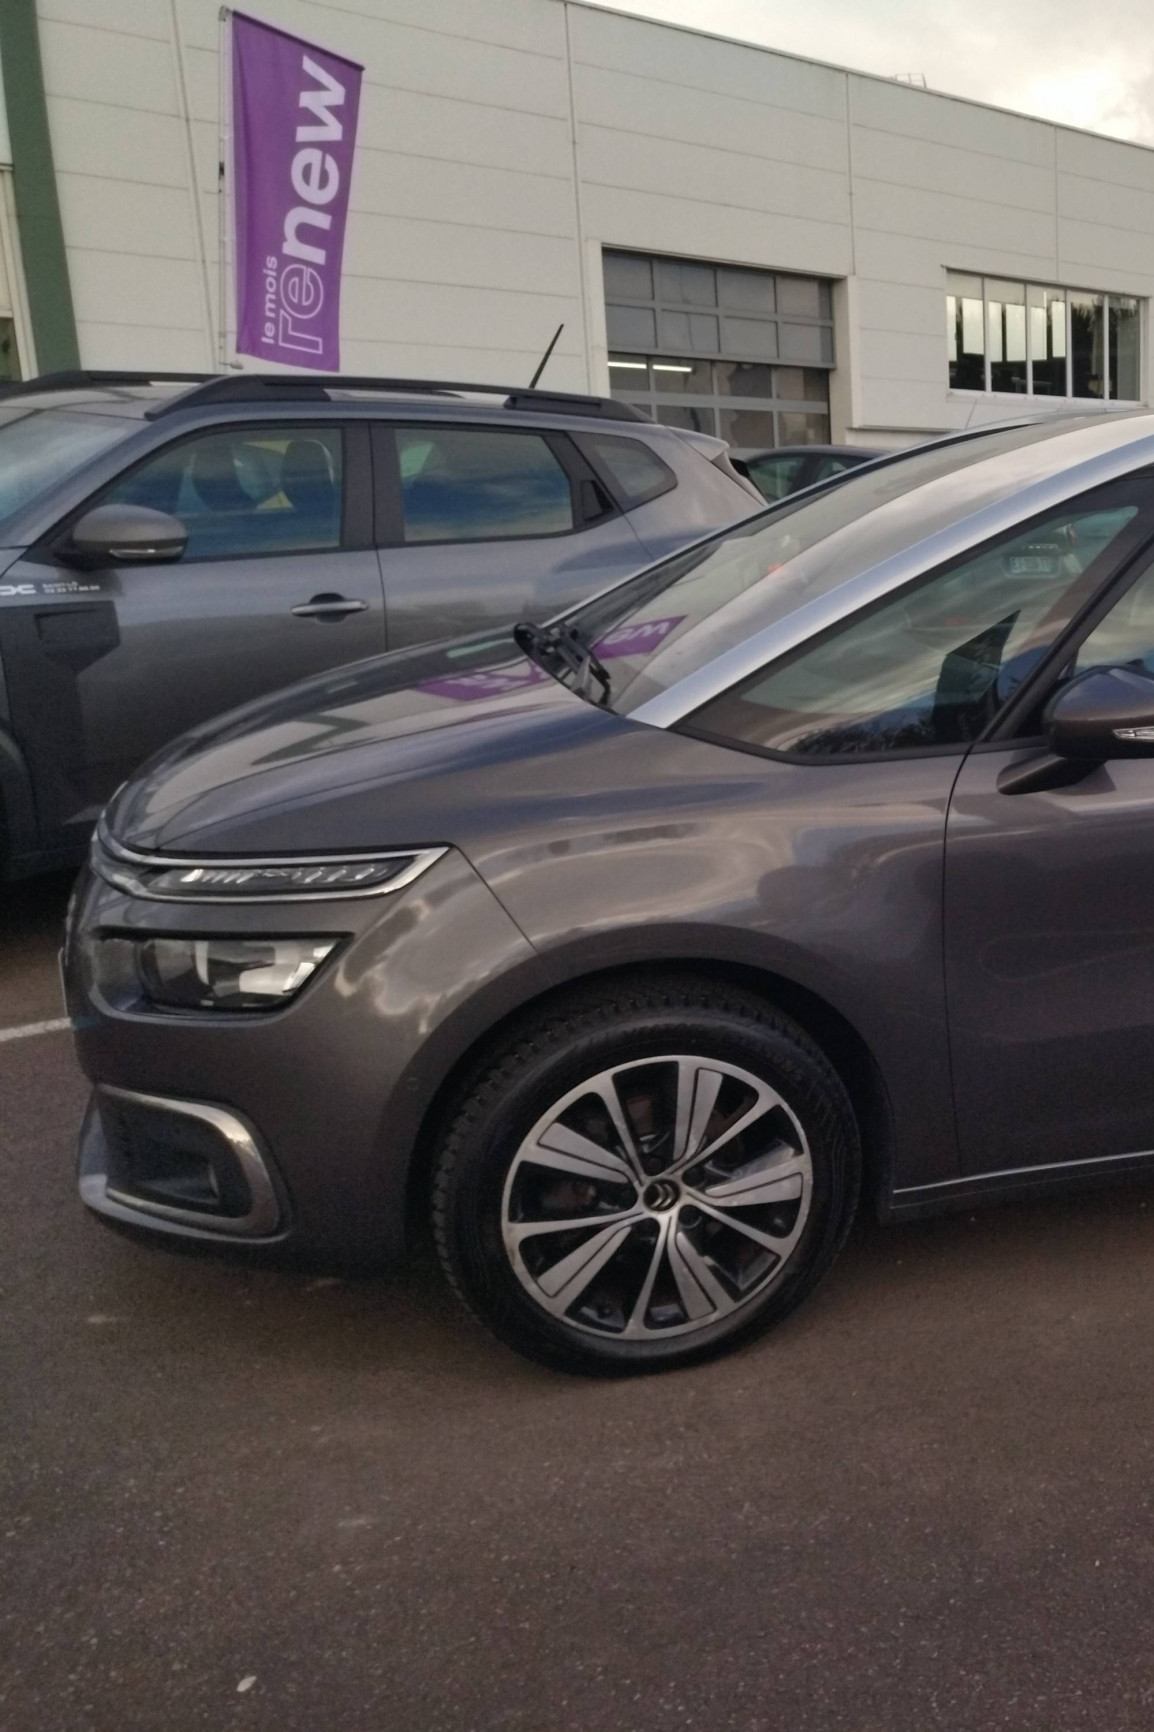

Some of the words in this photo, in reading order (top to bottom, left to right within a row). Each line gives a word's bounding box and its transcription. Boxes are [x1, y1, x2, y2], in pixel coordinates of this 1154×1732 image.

[278, 55, 346, 355] renew
[265, 256, 278, 318] mois
[261, 323, 275, 344] le
